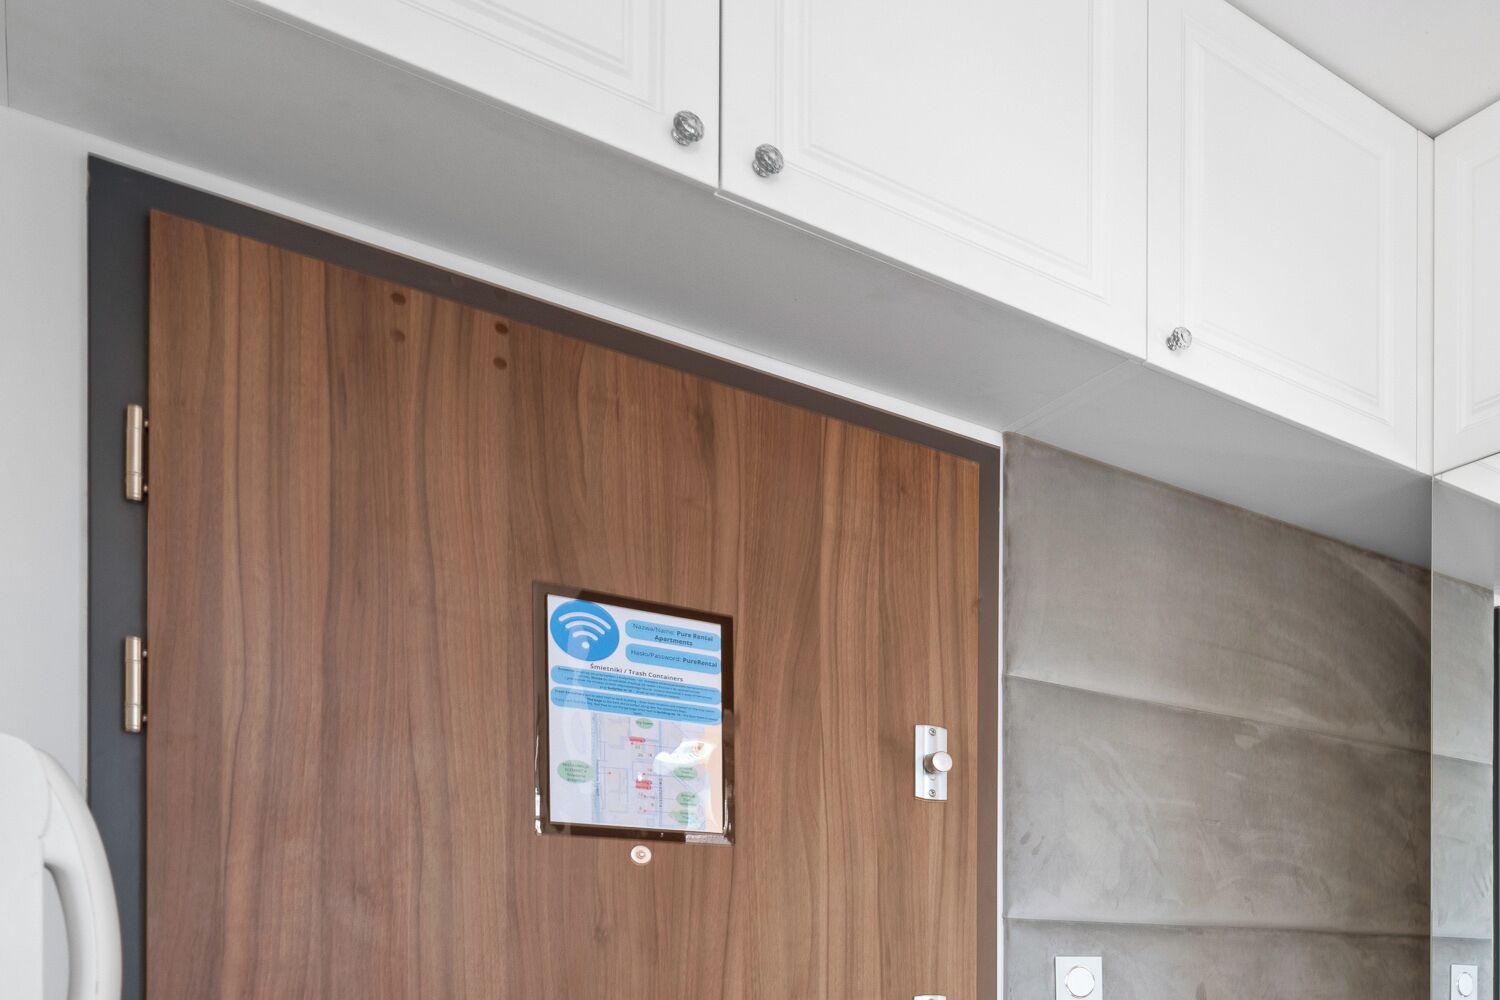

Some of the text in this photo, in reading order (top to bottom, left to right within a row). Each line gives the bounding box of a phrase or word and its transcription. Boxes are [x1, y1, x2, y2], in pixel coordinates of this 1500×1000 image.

[654, 635, 693, 647] Apartments
[676, 630, 691, 638] Pure
[692, 633, 714, 642] Rental
[682, 657, 718, 668] PureRental
[590, 663, 623, 673] Śmietniki
[629, 669, 647, 677] Trash
[648, 672, 684, 682] Containers
